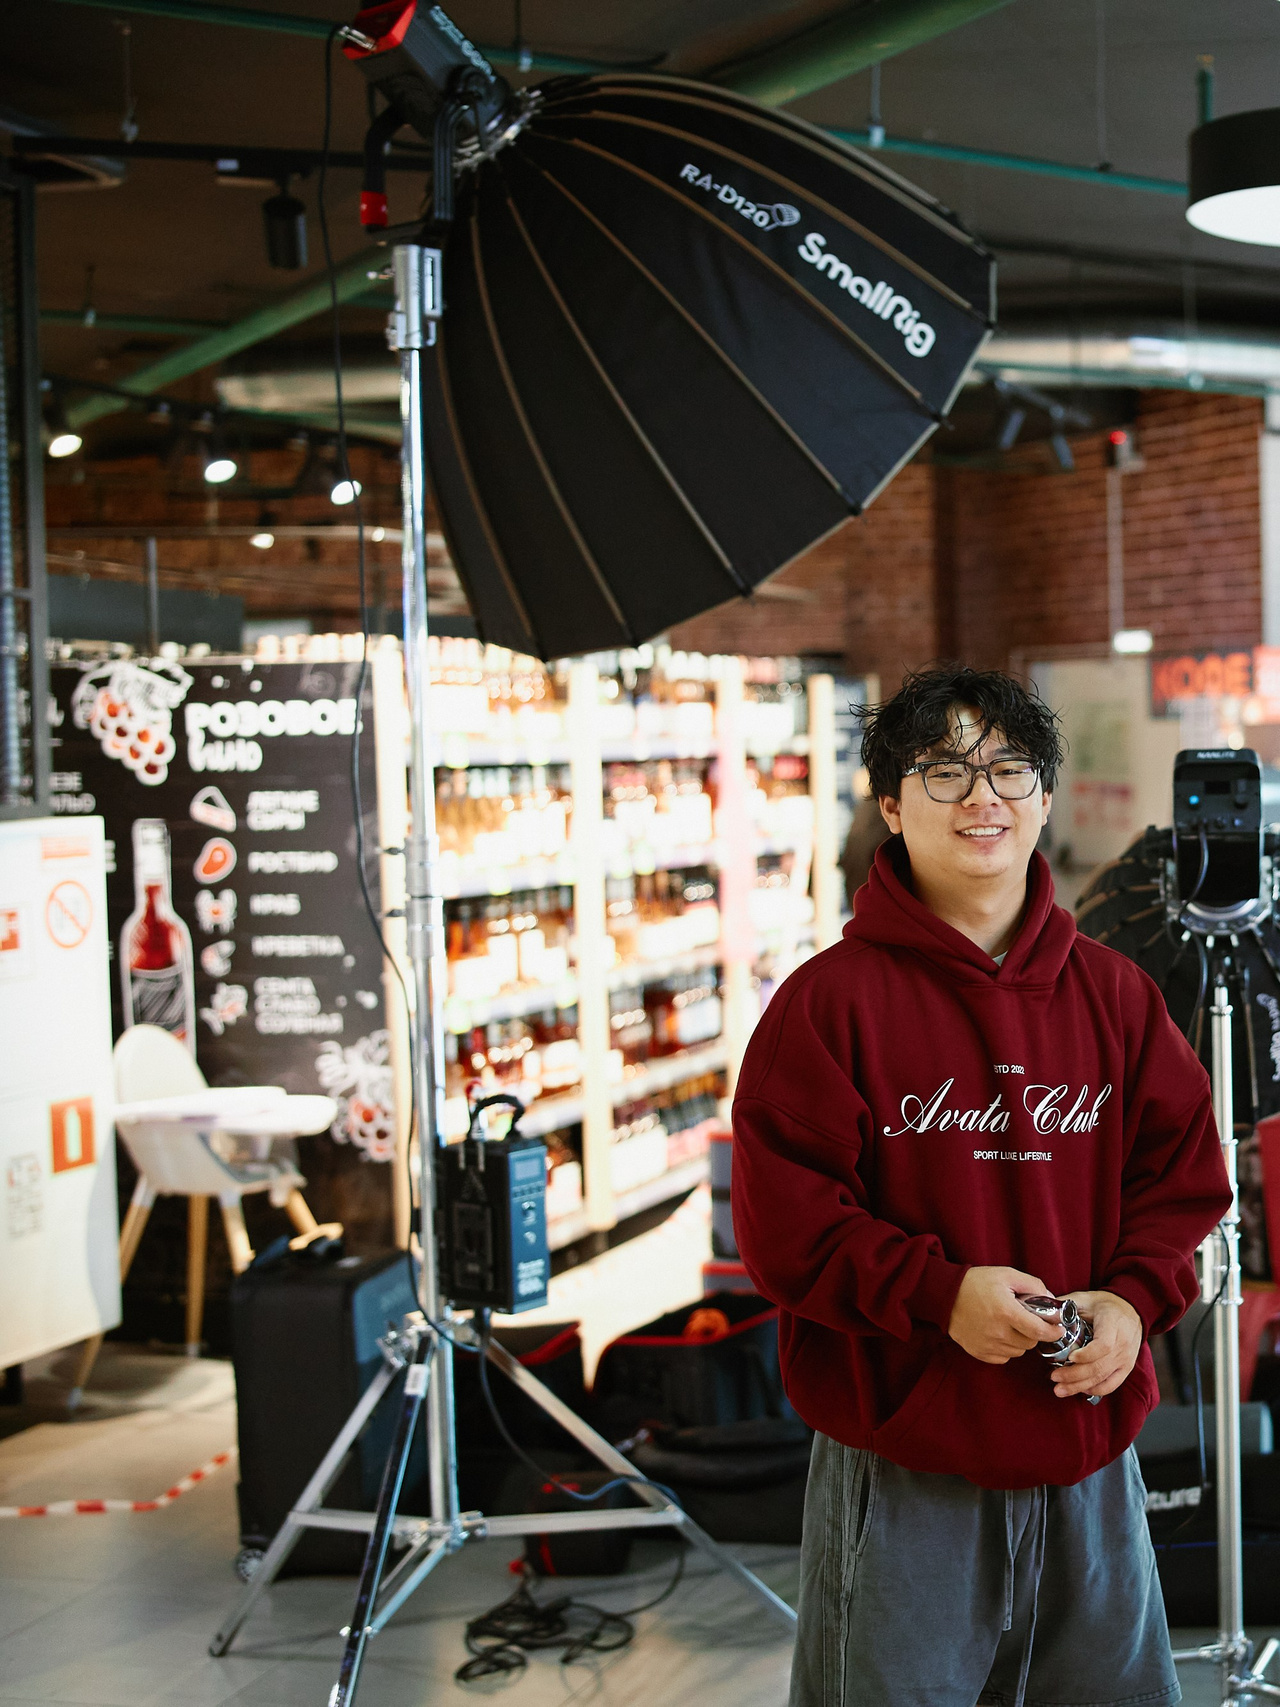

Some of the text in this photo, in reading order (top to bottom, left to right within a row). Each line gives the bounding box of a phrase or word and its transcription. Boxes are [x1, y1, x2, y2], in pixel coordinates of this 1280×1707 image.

[679, 163, 770, 228] RA-D120
[798, 232, 937, 358] SmallRig
[883, 1077, 1113, 1137] Avata Club
[973, 1150, 999, 1160] SPORT
